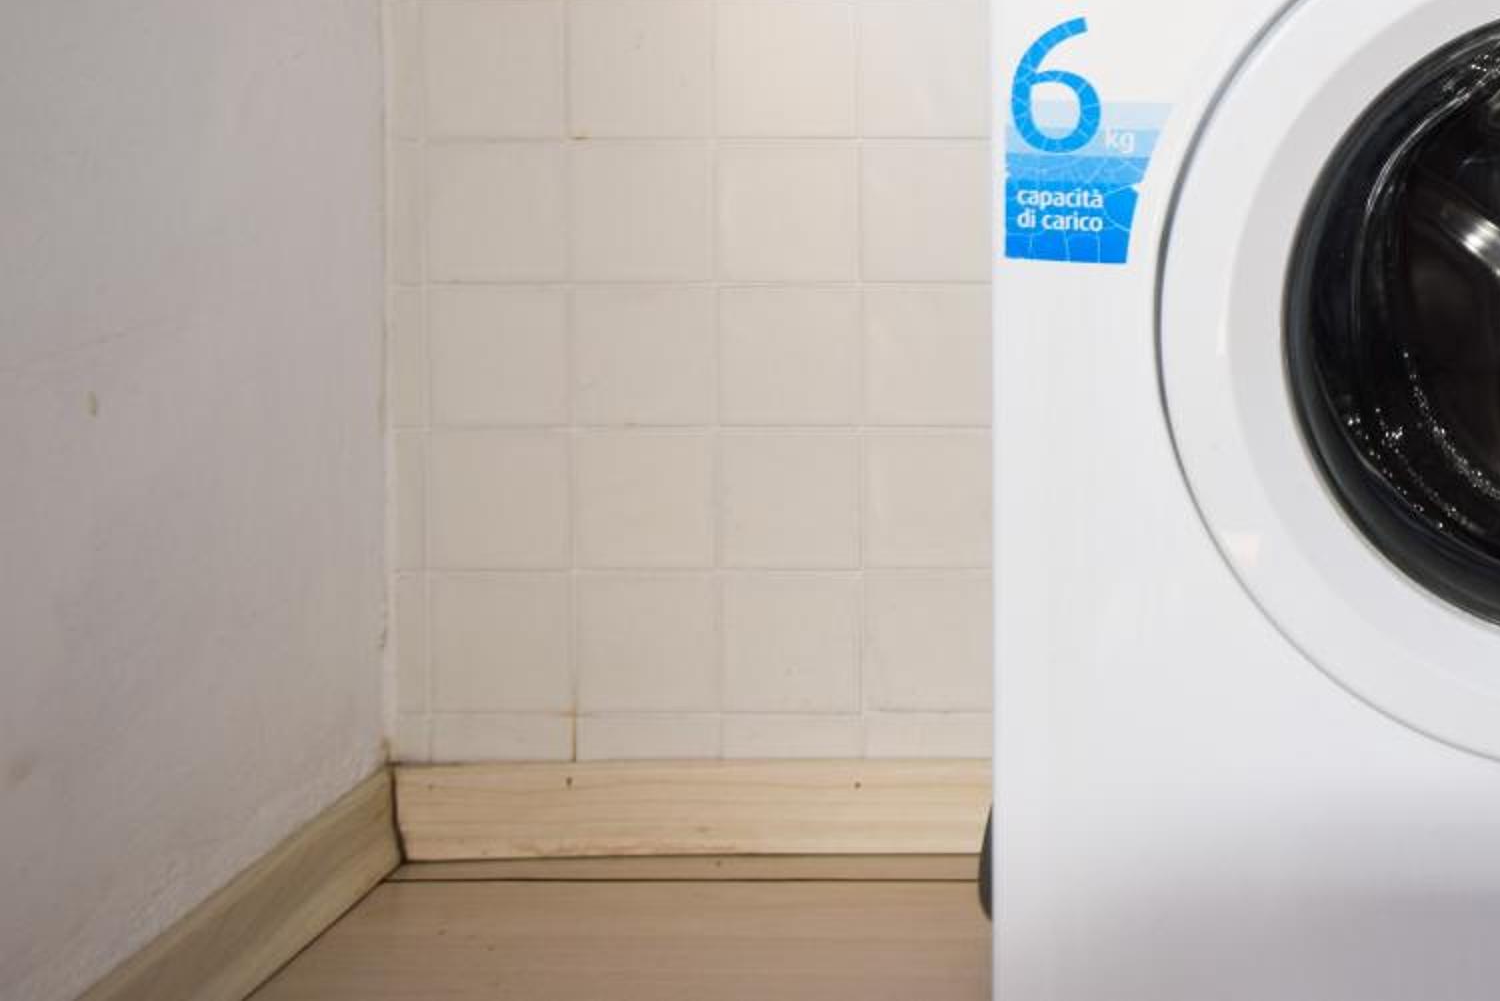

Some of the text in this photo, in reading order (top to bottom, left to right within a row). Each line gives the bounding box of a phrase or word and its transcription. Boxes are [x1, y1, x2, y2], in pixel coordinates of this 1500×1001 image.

[1012, 16, 1136, 155] 6 kg
[1016, 187, 1104, 209] capacità
[1016, 209, 1103, 231] di carico
